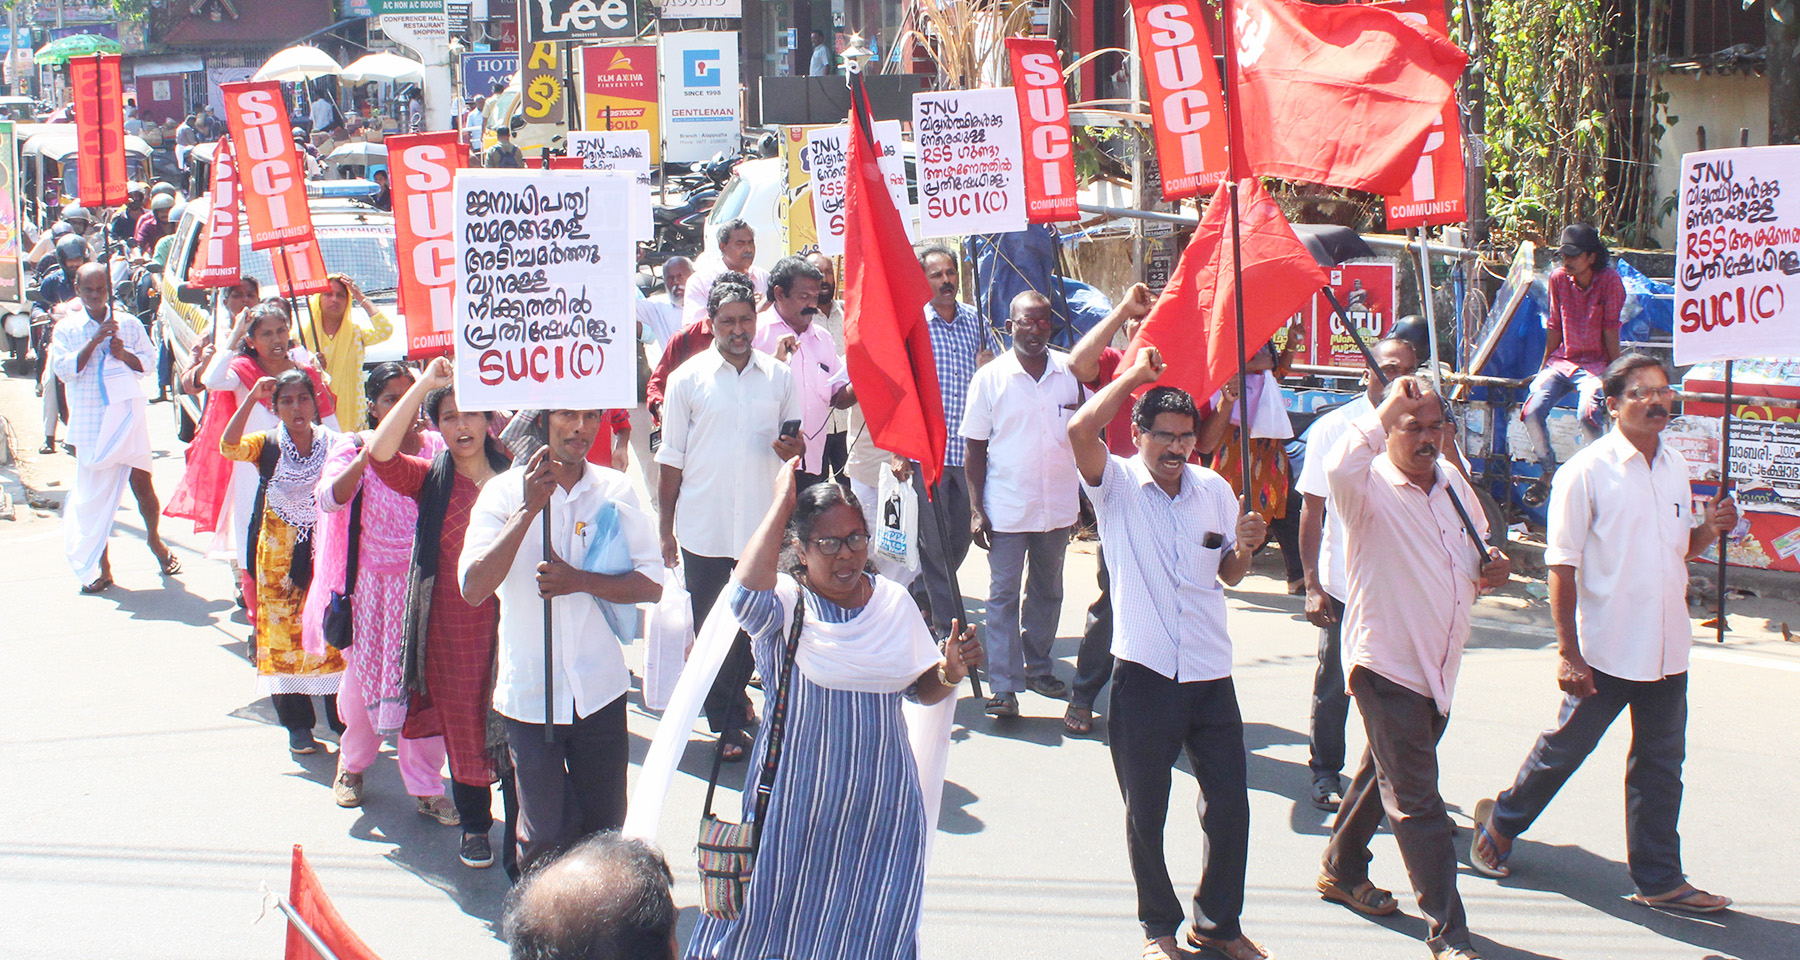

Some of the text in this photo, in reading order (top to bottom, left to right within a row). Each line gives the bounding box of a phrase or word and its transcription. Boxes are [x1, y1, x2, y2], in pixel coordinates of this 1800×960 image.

[394, 1, 408, 9] NON
[420, 1, 443, 9] ROOMS
[538, 0, 629, 33] Lee
[597, 74, 614, 82] KLM
[1147, 4, 1211, 175] SUCI
[671, 108, 735, 117] GENTLEMAN
[920, 98, 958, 115] JNU
[1021, 54, 1069, 196] SUCI
[577, 137, 605, 150] JNU
[812, 136, 840, 154] JNU
[237, 90, 293, 229] SUCI
[922, 145, 952, 164] RSS
[1165, 171, 1226, 191] COMMUNIST
[1689, 160, 1733, 184] JNU
[1031, 197, 1076, 210] COMMUNIST
[1391, 199, 1458, 219] COMMUNIST
[256, 224, 308, 241] COMMUNIST
[1686, 225, 1727, 260] RSS
[479, 341, 605, 386] SUCI(C)
